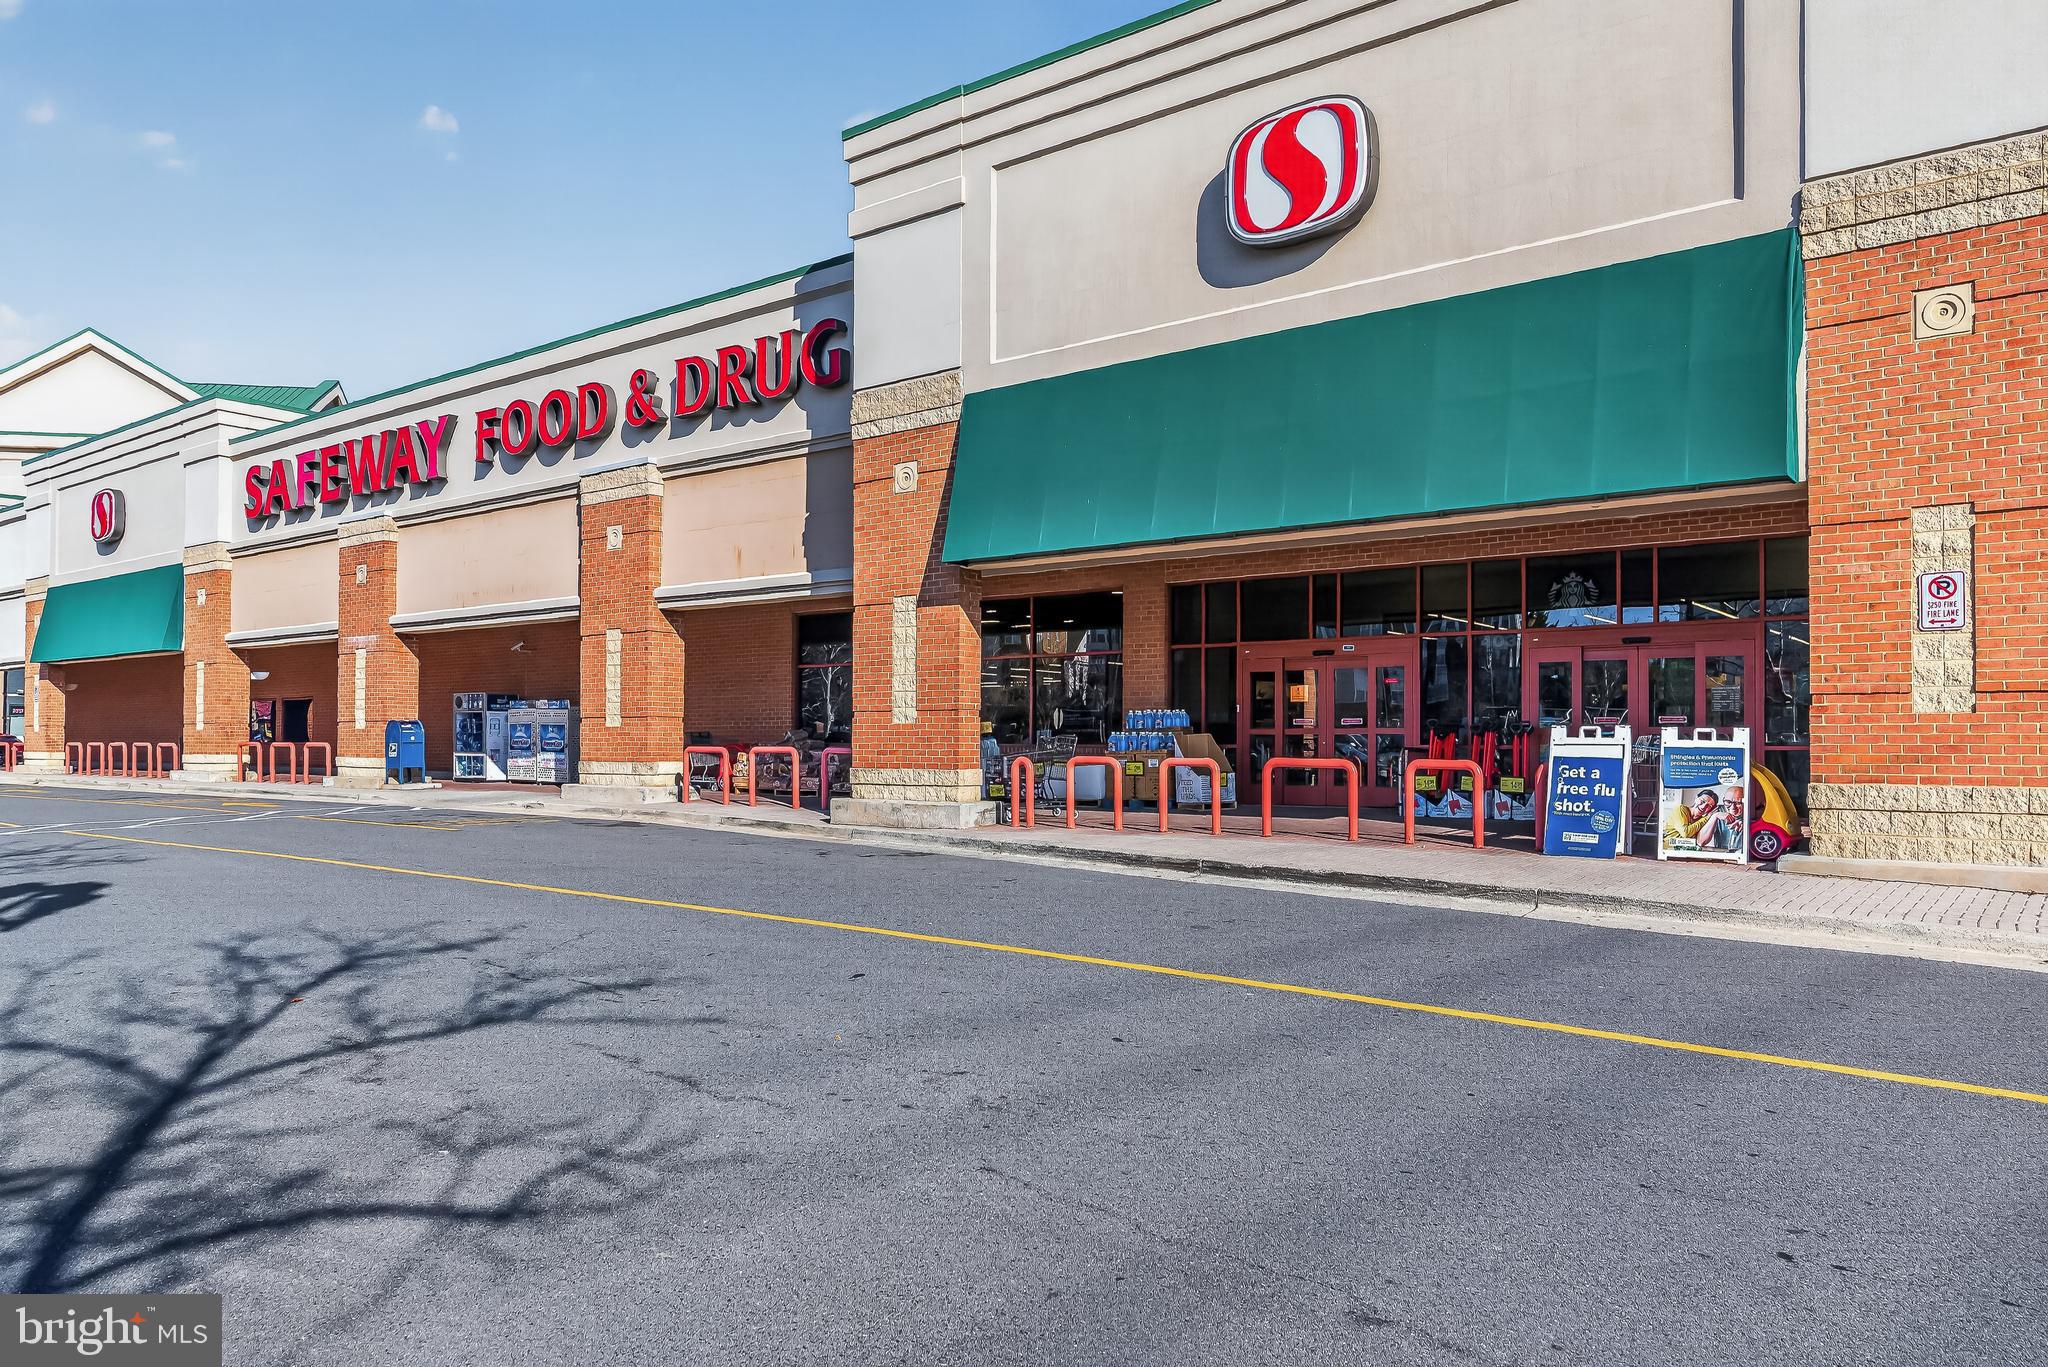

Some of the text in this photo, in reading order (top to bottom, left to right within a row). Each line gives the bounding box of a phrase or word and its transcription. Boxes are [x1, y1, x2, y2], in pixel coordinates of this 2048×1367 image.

[244, 317, 850, 519] SAFEWAY FOOD & DRUG
[1927, 600, 1958, 609] $250 FINE
[1927, 609, 1959, 618] FIRE LANE
[1559, 765, 1600, 779] Get a
[1557, 782, 1616, 797] free flu
